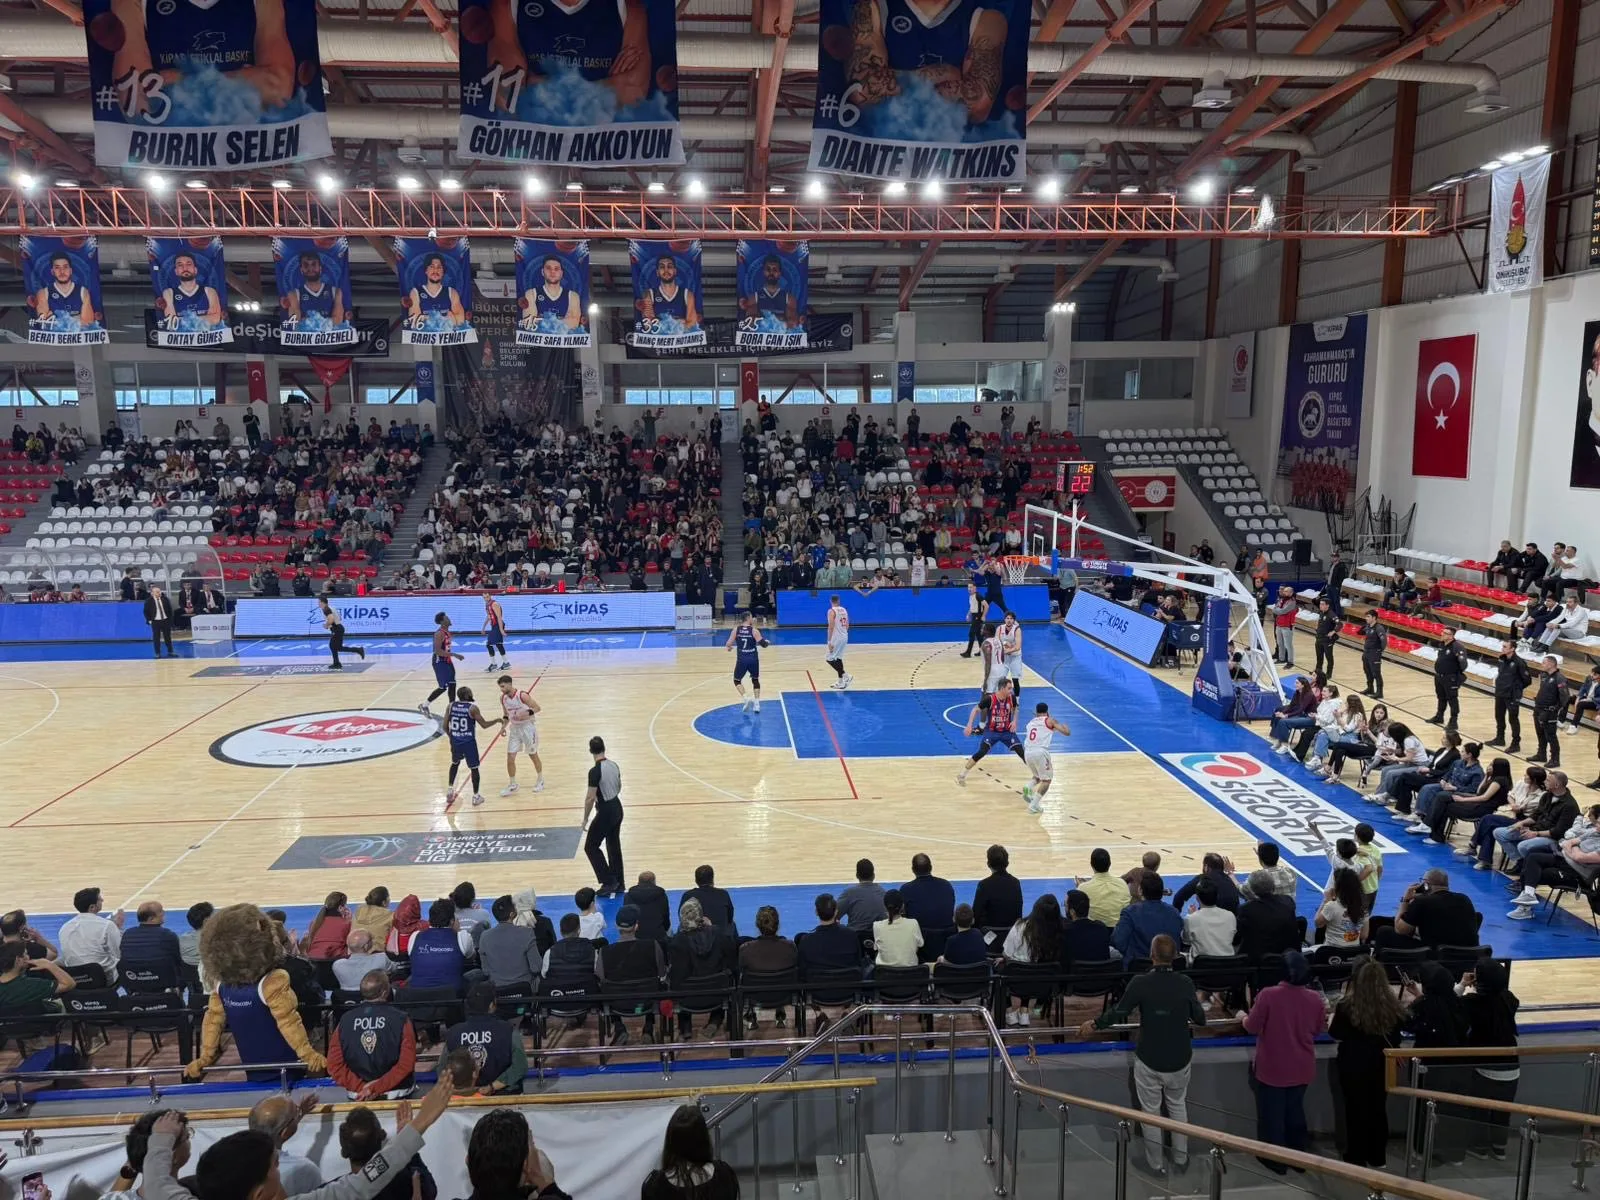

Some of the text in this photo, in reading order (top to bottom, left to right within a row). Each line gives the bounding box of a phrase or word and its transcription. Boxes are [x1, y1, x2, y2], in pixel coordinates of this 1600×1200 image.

[96, 67, 171, 124] #13
[462, 64, 525, 114] #11
[819, 82, 863, 128] #6
[128, 123, 301, 166] BURAK SELEN
[469, 121, 673, 162] GÖKHAN AKKOYUN
[818, 135, 1019, 179] DIANTE WATKINS
[635, 317, 661, 334] #33
[738, 317, 763, 332] #25
[30, 331, 55, 343] BERAT
[57, 333, 82, 345] BERKE
[167, 332, 193, 345] OKTAY
[285, 333, 312, 344] BURAK
[518, 333, 589, 346] AHMET SAFA YILMAZ
[656, 336, 675, 347] MERT
[740, 333, 764, 345] BORA
[765, 334, 784, 346] CAN
[1308, 362, 1348, 385] GURURU
[15, 408, 24, 418] E
[198, 407, 206, 416] E
[1071, 475, 1091, 492] 22
[343, 604, 390, 620] KİPAŞ
[564, 600, 609, 616] KİPAŞ
[741, 638, 748, 649] 7
[451, 717, 468, 731] 69
[1029, 728, 1038, 740] 6
[420, 845, 537, 857] BASKETBOL
